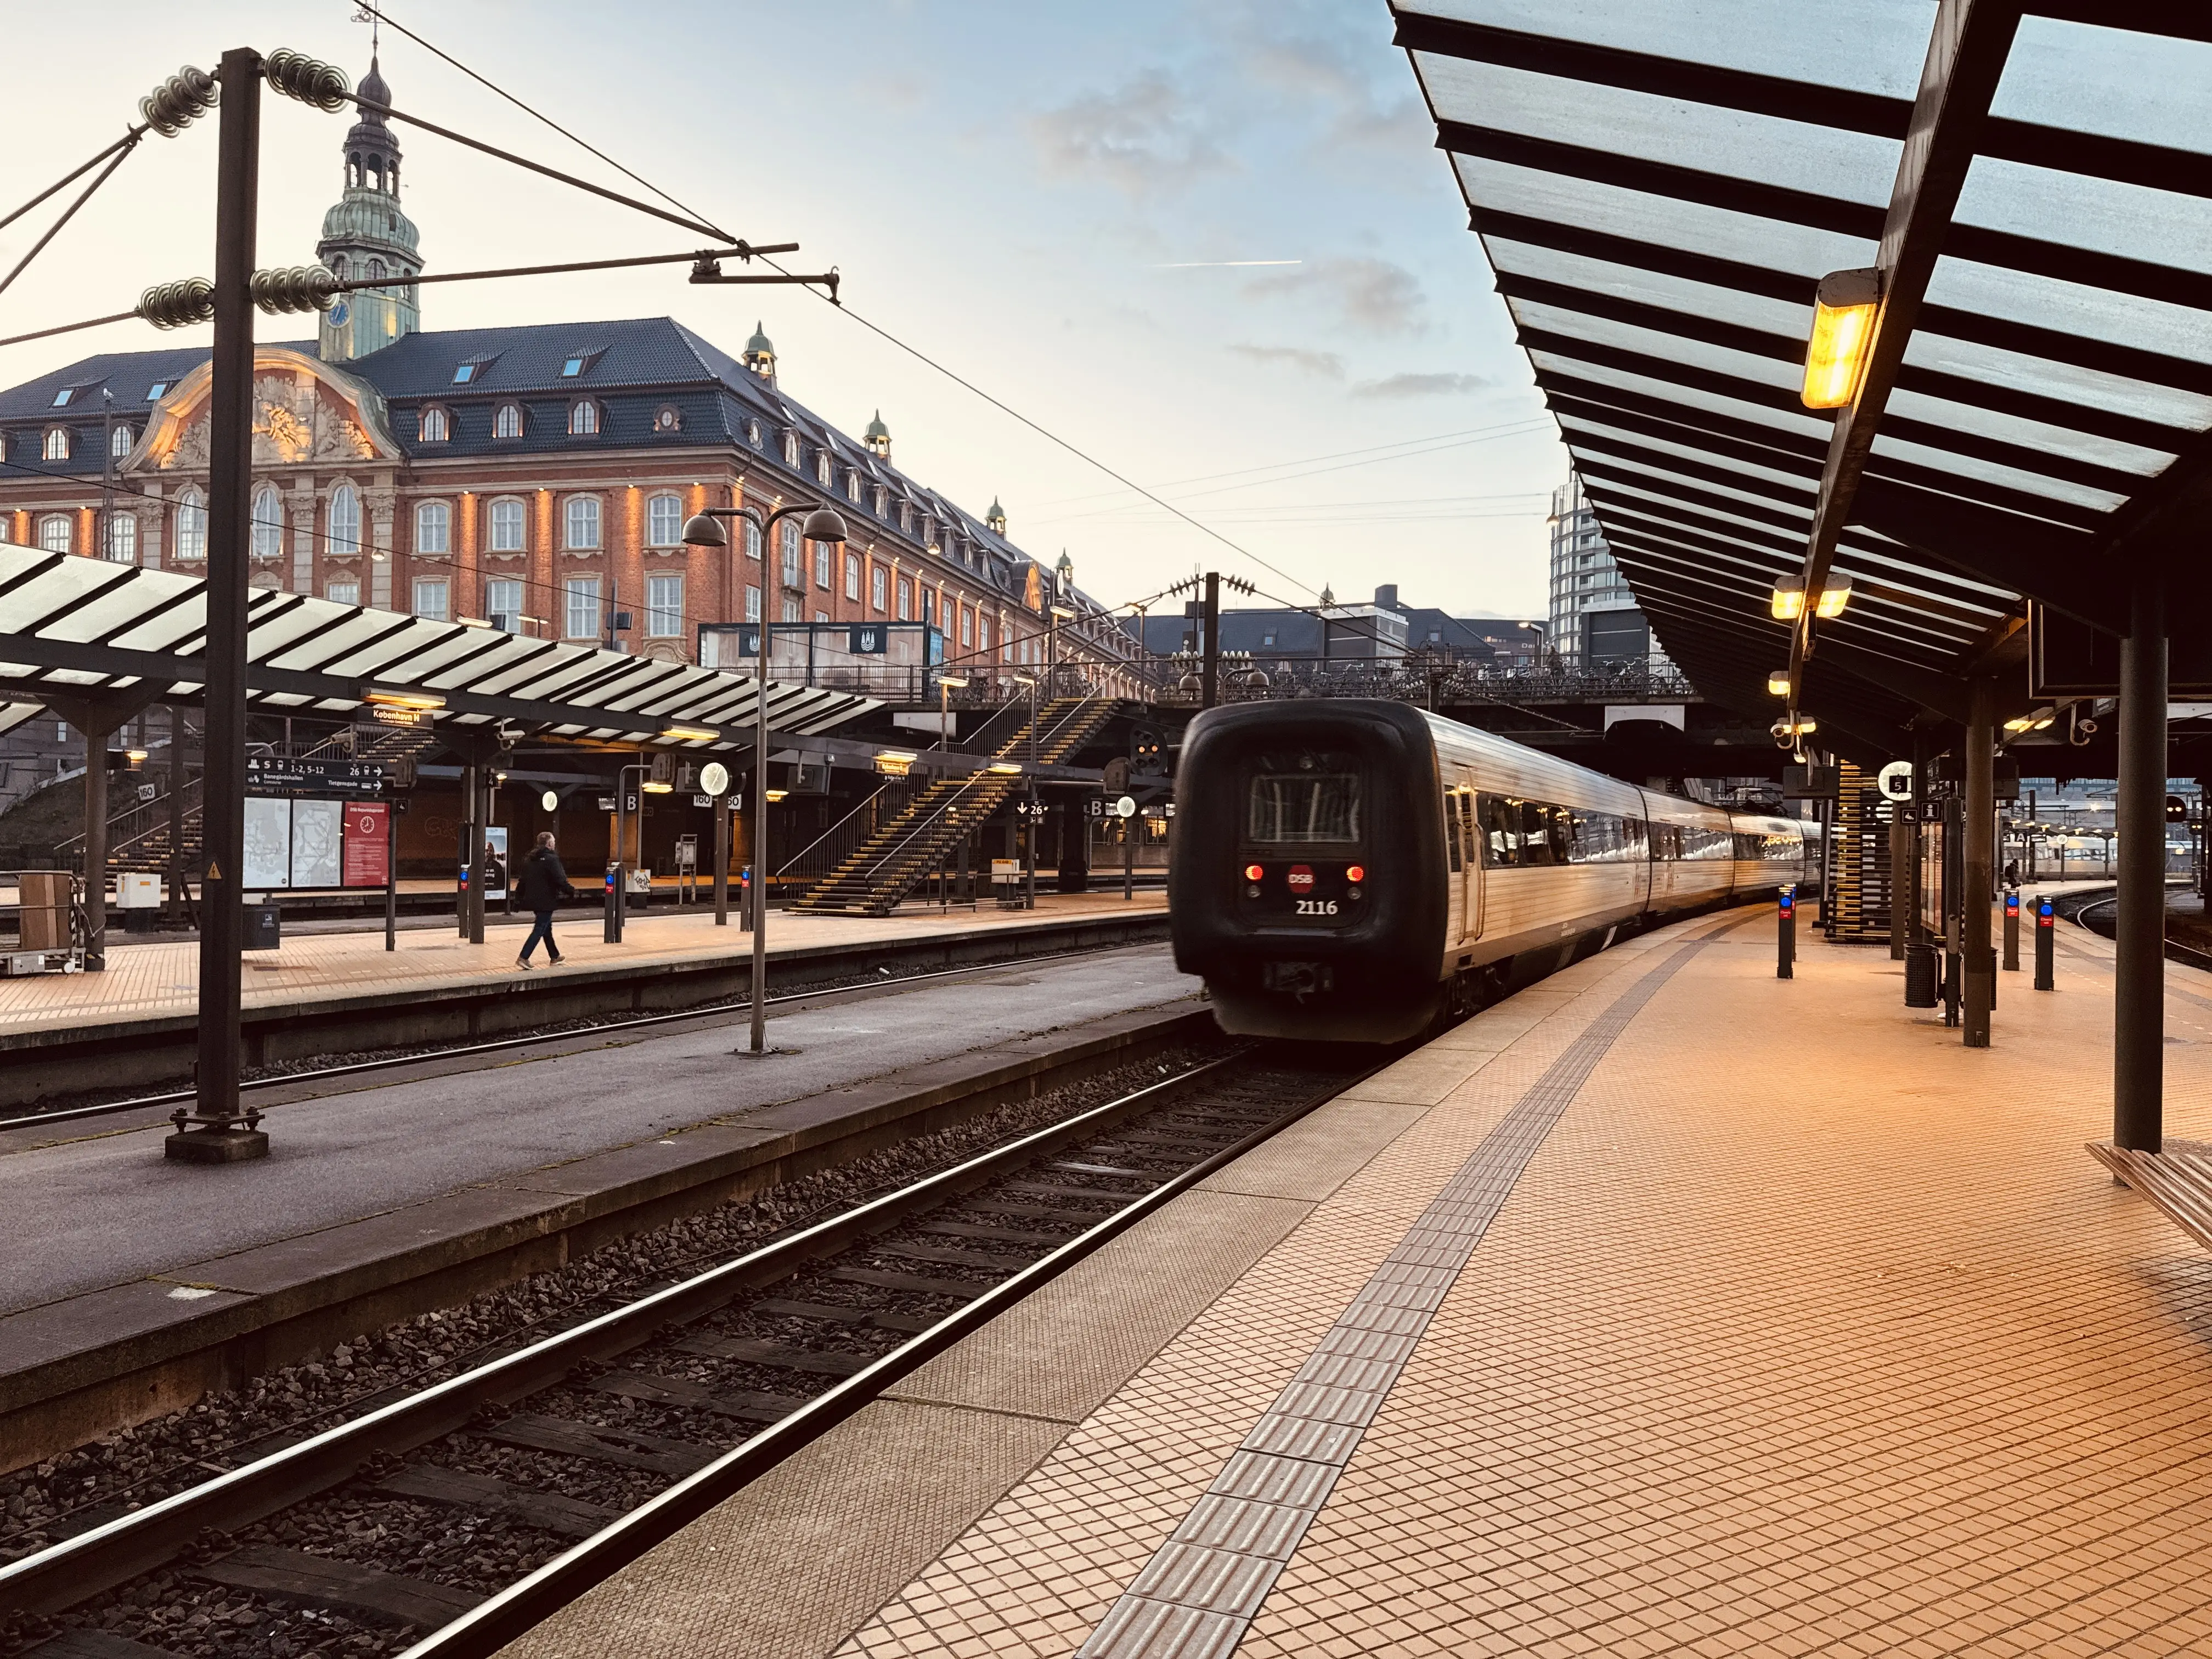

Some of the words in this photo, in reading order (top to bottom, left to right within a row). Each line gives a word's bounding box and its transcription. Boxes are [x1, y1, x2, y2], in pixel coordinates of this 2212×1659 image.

[373, 709, 413, 721] København
[414, 713, 420, 722] H
[264, 760, 270, 769] S
[307, 765, 324, 775] 5-12
[349, 767, 360, 776] 26
[139, 786, 153, 798] 160
[1894, 781, 1902, 791] 5
[627, 795, 636, 811] B
[1091, 800, 1102, 816] B
[1030, 805, 1042, 815] 26
[2016, 833, 2025, 842] A
[1288, 874, 1313, 884] DSB
[1295, 900, 1339, 915] 2116
